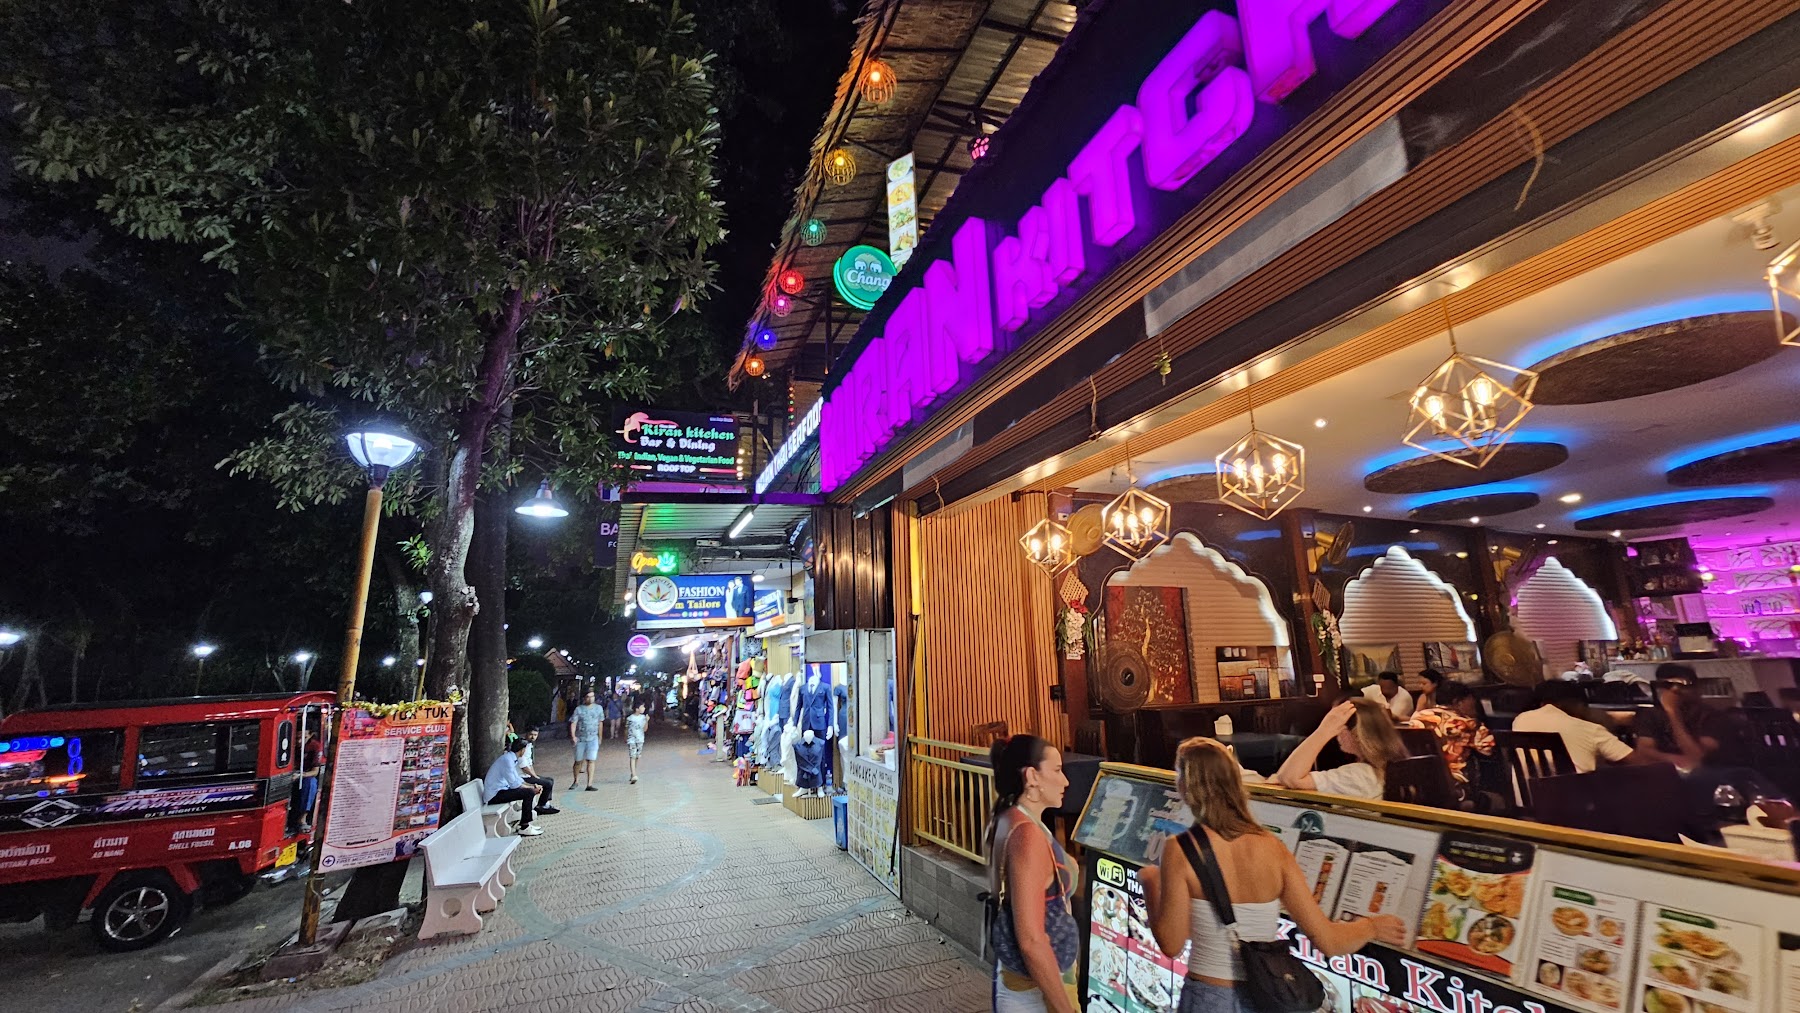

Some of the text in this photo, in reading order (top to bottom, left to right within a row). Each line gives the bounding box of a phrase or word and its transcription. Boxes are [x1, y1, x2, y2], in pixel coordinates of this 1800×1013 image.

[847, 268, 891, 290] Chang
[641, 423, 735, 440] Kiran kitchen
[640, 436, 716, 452] Bar & Dining
[657, 453, 678, 463] Vegan
[679, 454, 685, 463] &
[684, 454, 719, 465] Vegetarian
[718, 457, 735, 465] Food
[632, 551, 659, 575] Open
[679, 586, 726, 597] FASHION
[688, 599, 721, 609] Tailors
[424, 706, 450, 719] TUK
[384, 724, 447, 736] SERVICE CLUB
[168, 805, 208, 816] NIGHTLY
[168, 839, 215, 851] SHELL FOSSIL
[228, 839, 252, 851] A.08
[103, 849, 125, 858] NANG
